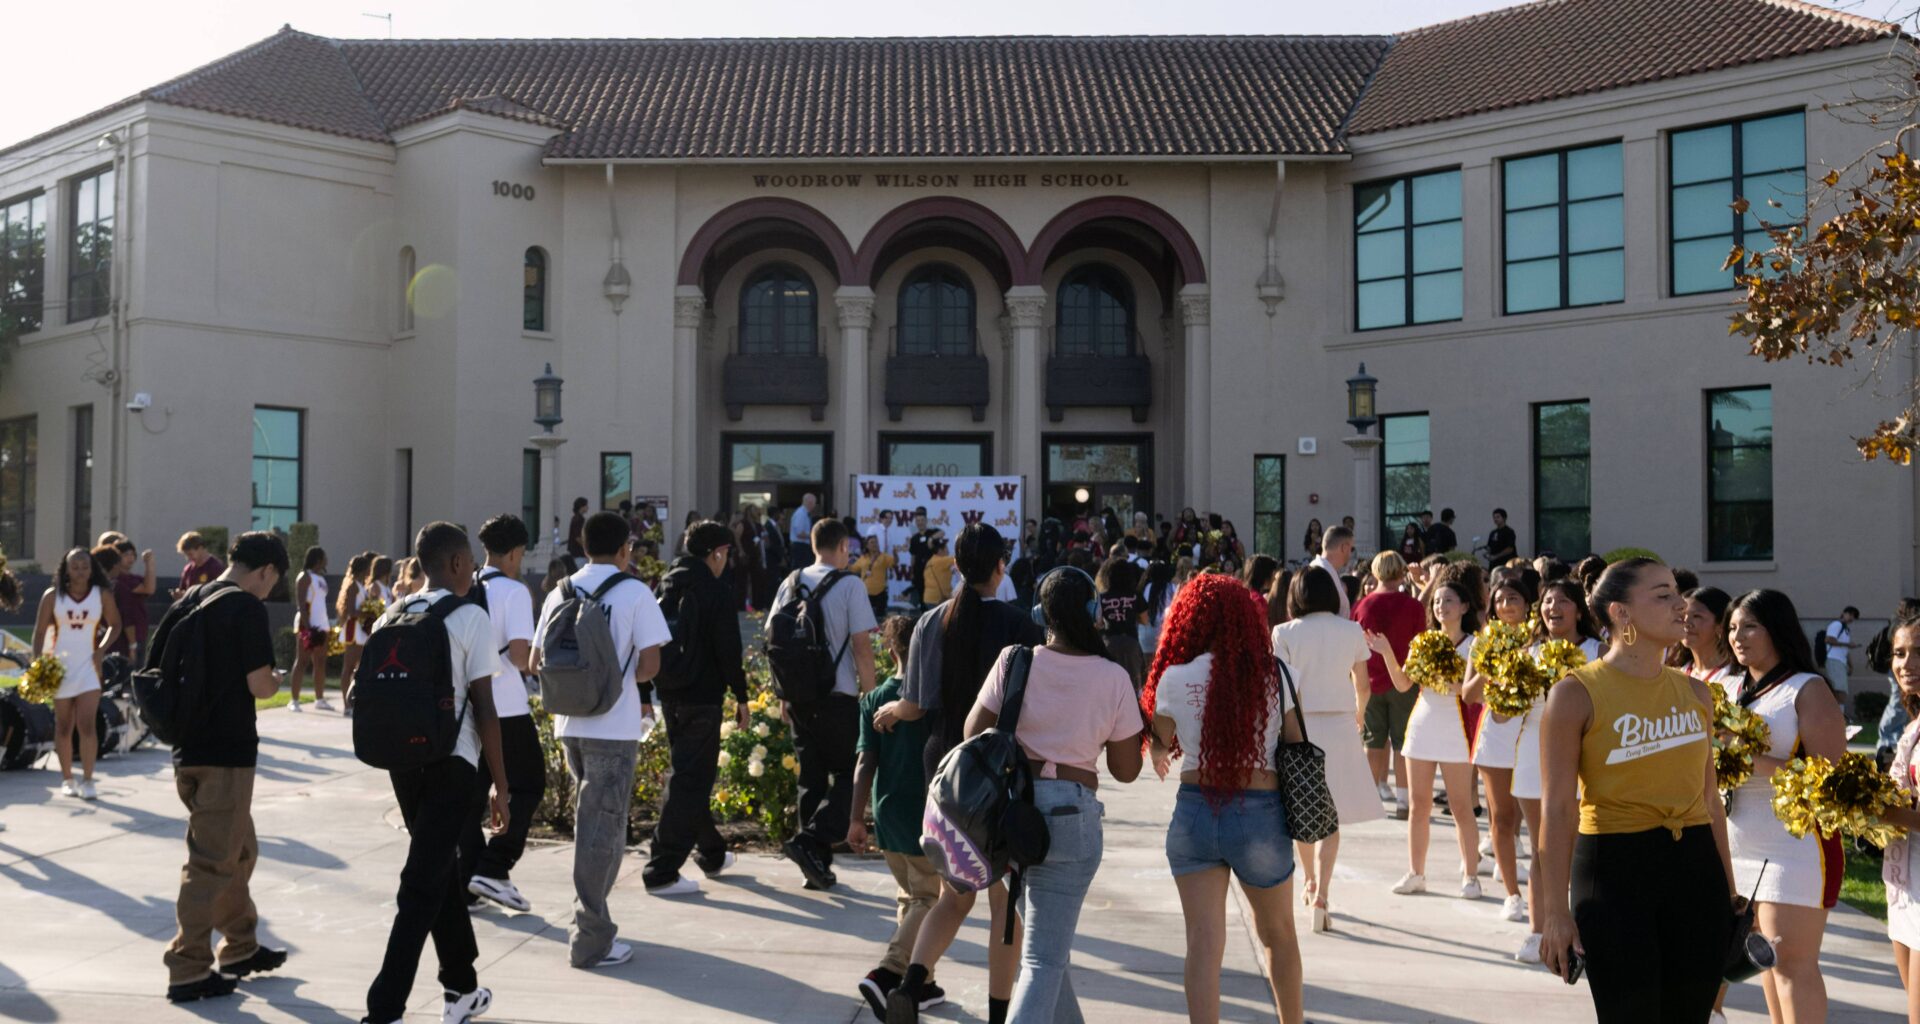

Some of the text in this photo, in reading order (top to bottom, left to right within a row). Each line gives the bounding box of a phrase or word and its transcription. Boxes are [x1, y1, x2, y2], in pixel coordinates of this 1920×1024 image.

[752, 174, 1129, 188] WOODROW WILSON HIGH SCHOOL
[492, 180, 535, 201] 1000
[910, 463, 960, 477] 4400
[860, 481, 884, 499] W
[926, 482, 951, 501] W
[994, 482, 1018, 501] W
[377, 671, 408, 679] AIR
[1613, 705, 1703, 748] Bruins
